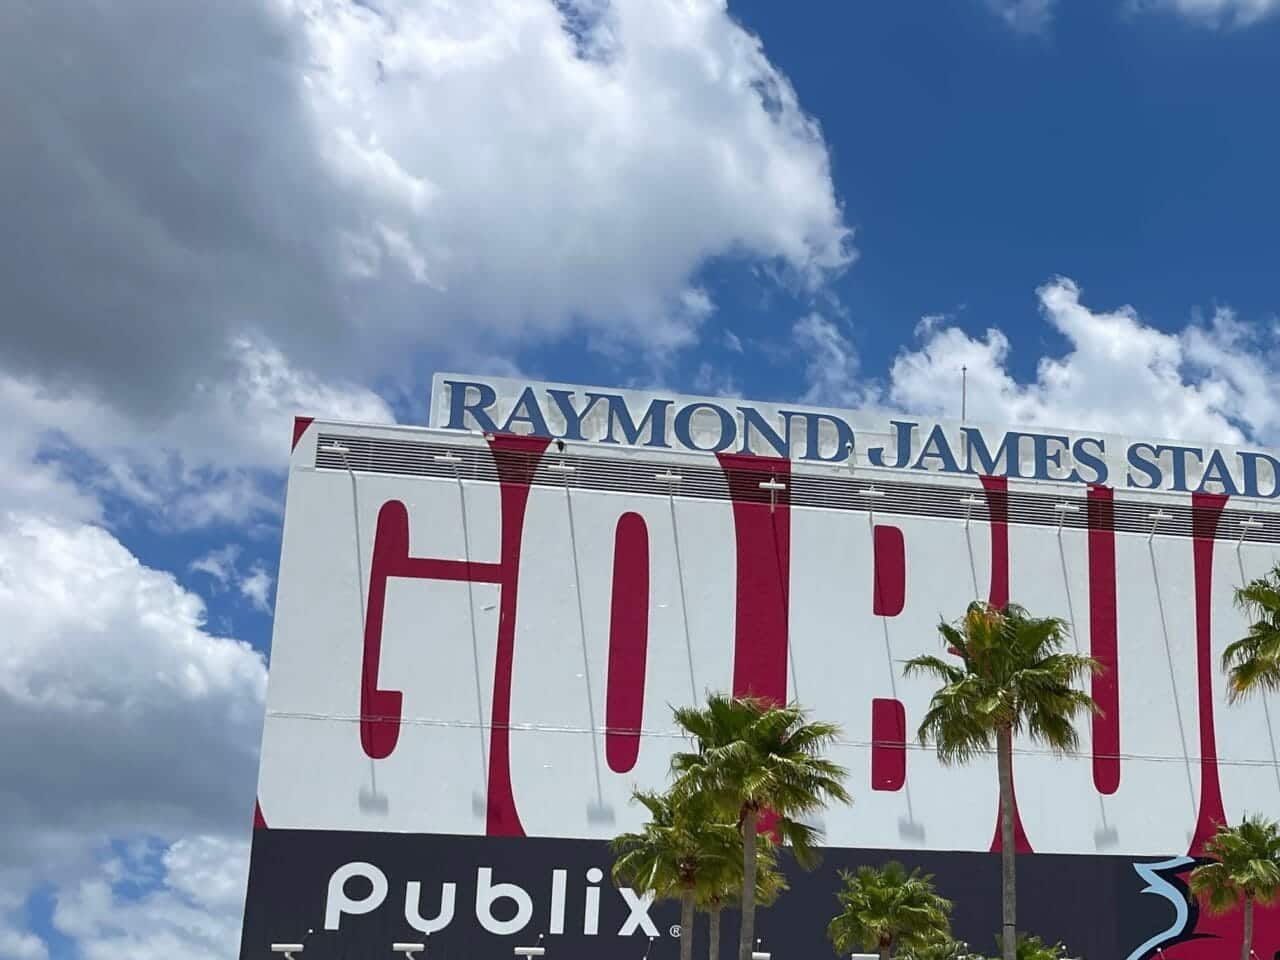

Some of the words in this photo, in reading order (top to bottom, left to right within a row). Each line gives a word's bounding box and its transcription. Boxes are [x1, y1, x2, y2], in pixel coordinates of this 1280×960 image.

[441, 380, 855, 463] RAYMOND
[868, 420, 1108, 486] JAMES
[325, 861, 661, 936] Publix
